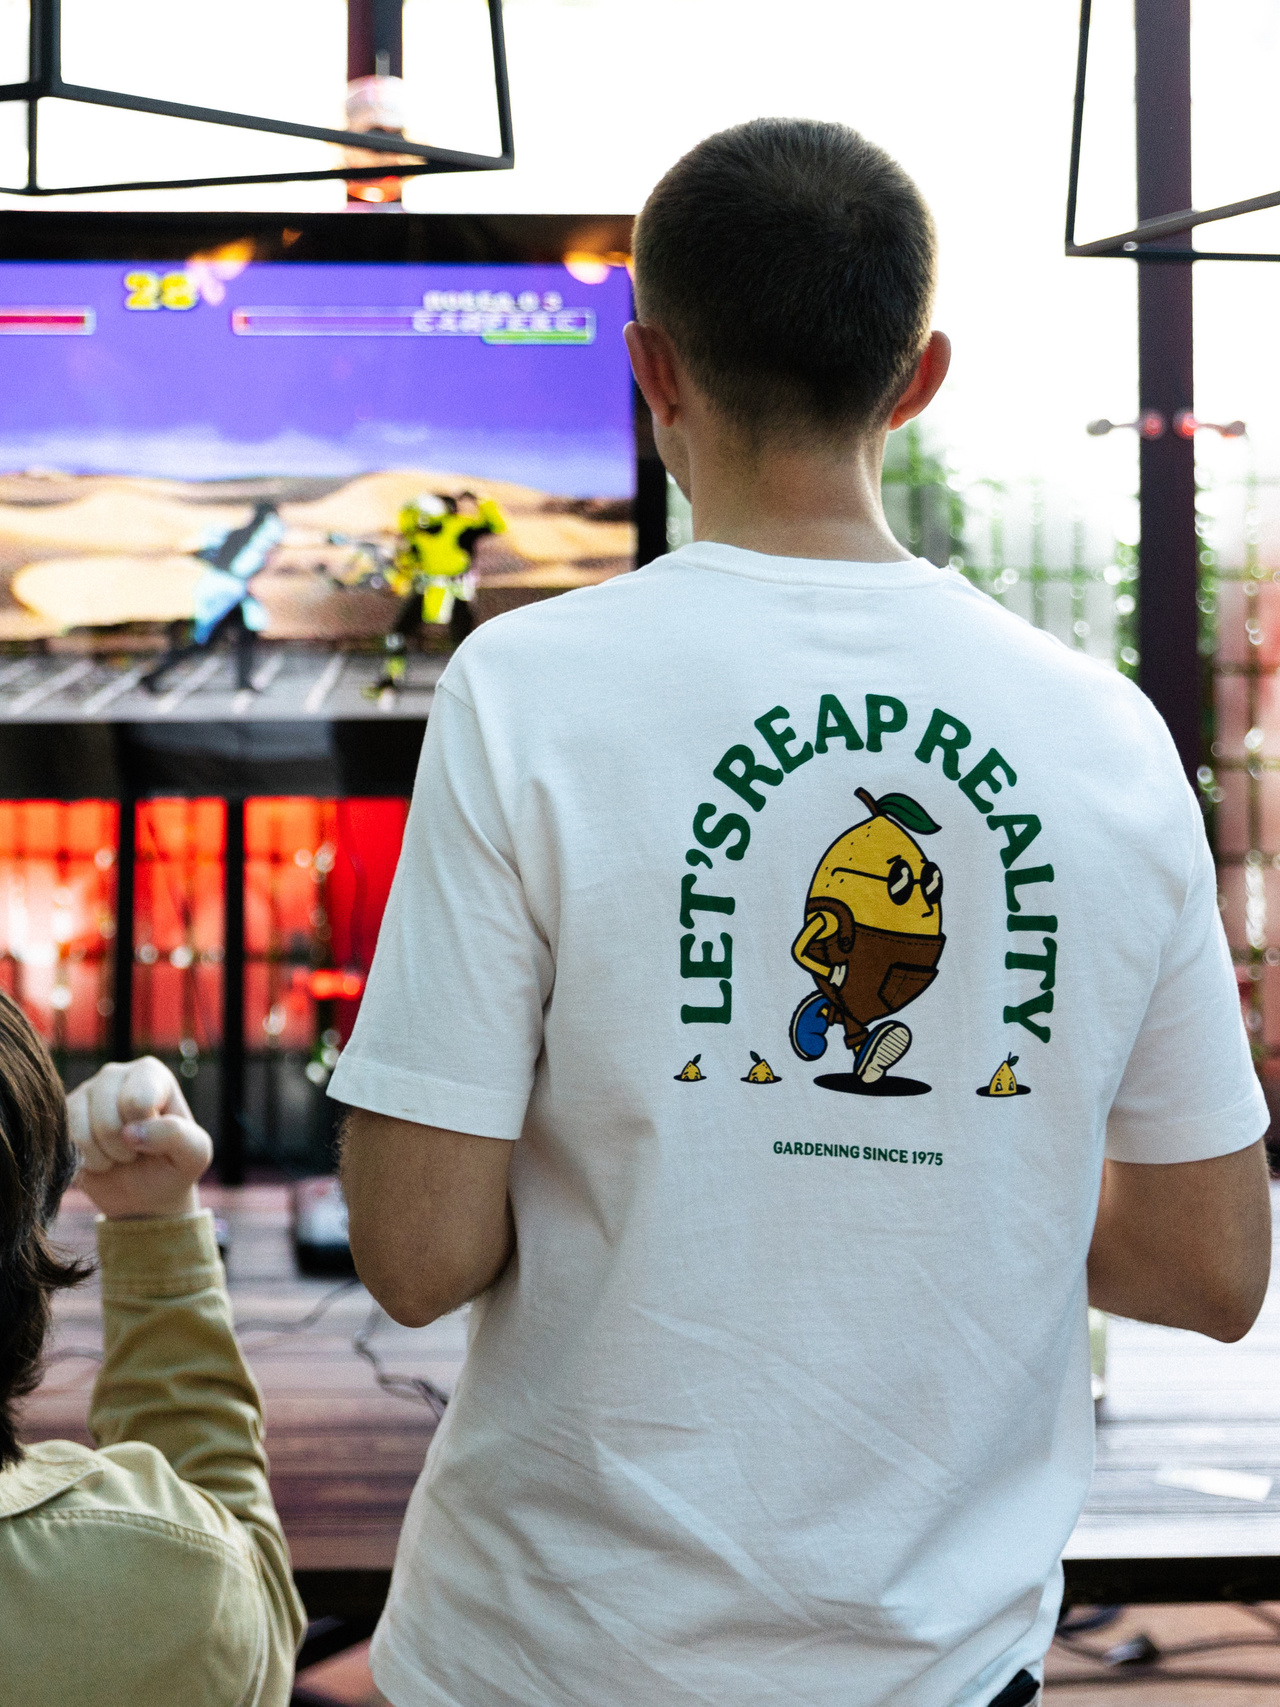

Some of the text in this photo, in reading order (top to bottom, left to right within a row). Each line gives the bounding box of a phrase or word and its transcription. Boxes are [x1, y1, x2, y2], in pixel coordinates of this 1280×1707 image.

[678, 692, 1060, 1045] LET'S REAP REALITY
[772, 1140, 944, 1167] GARDENING SINCE 1975
